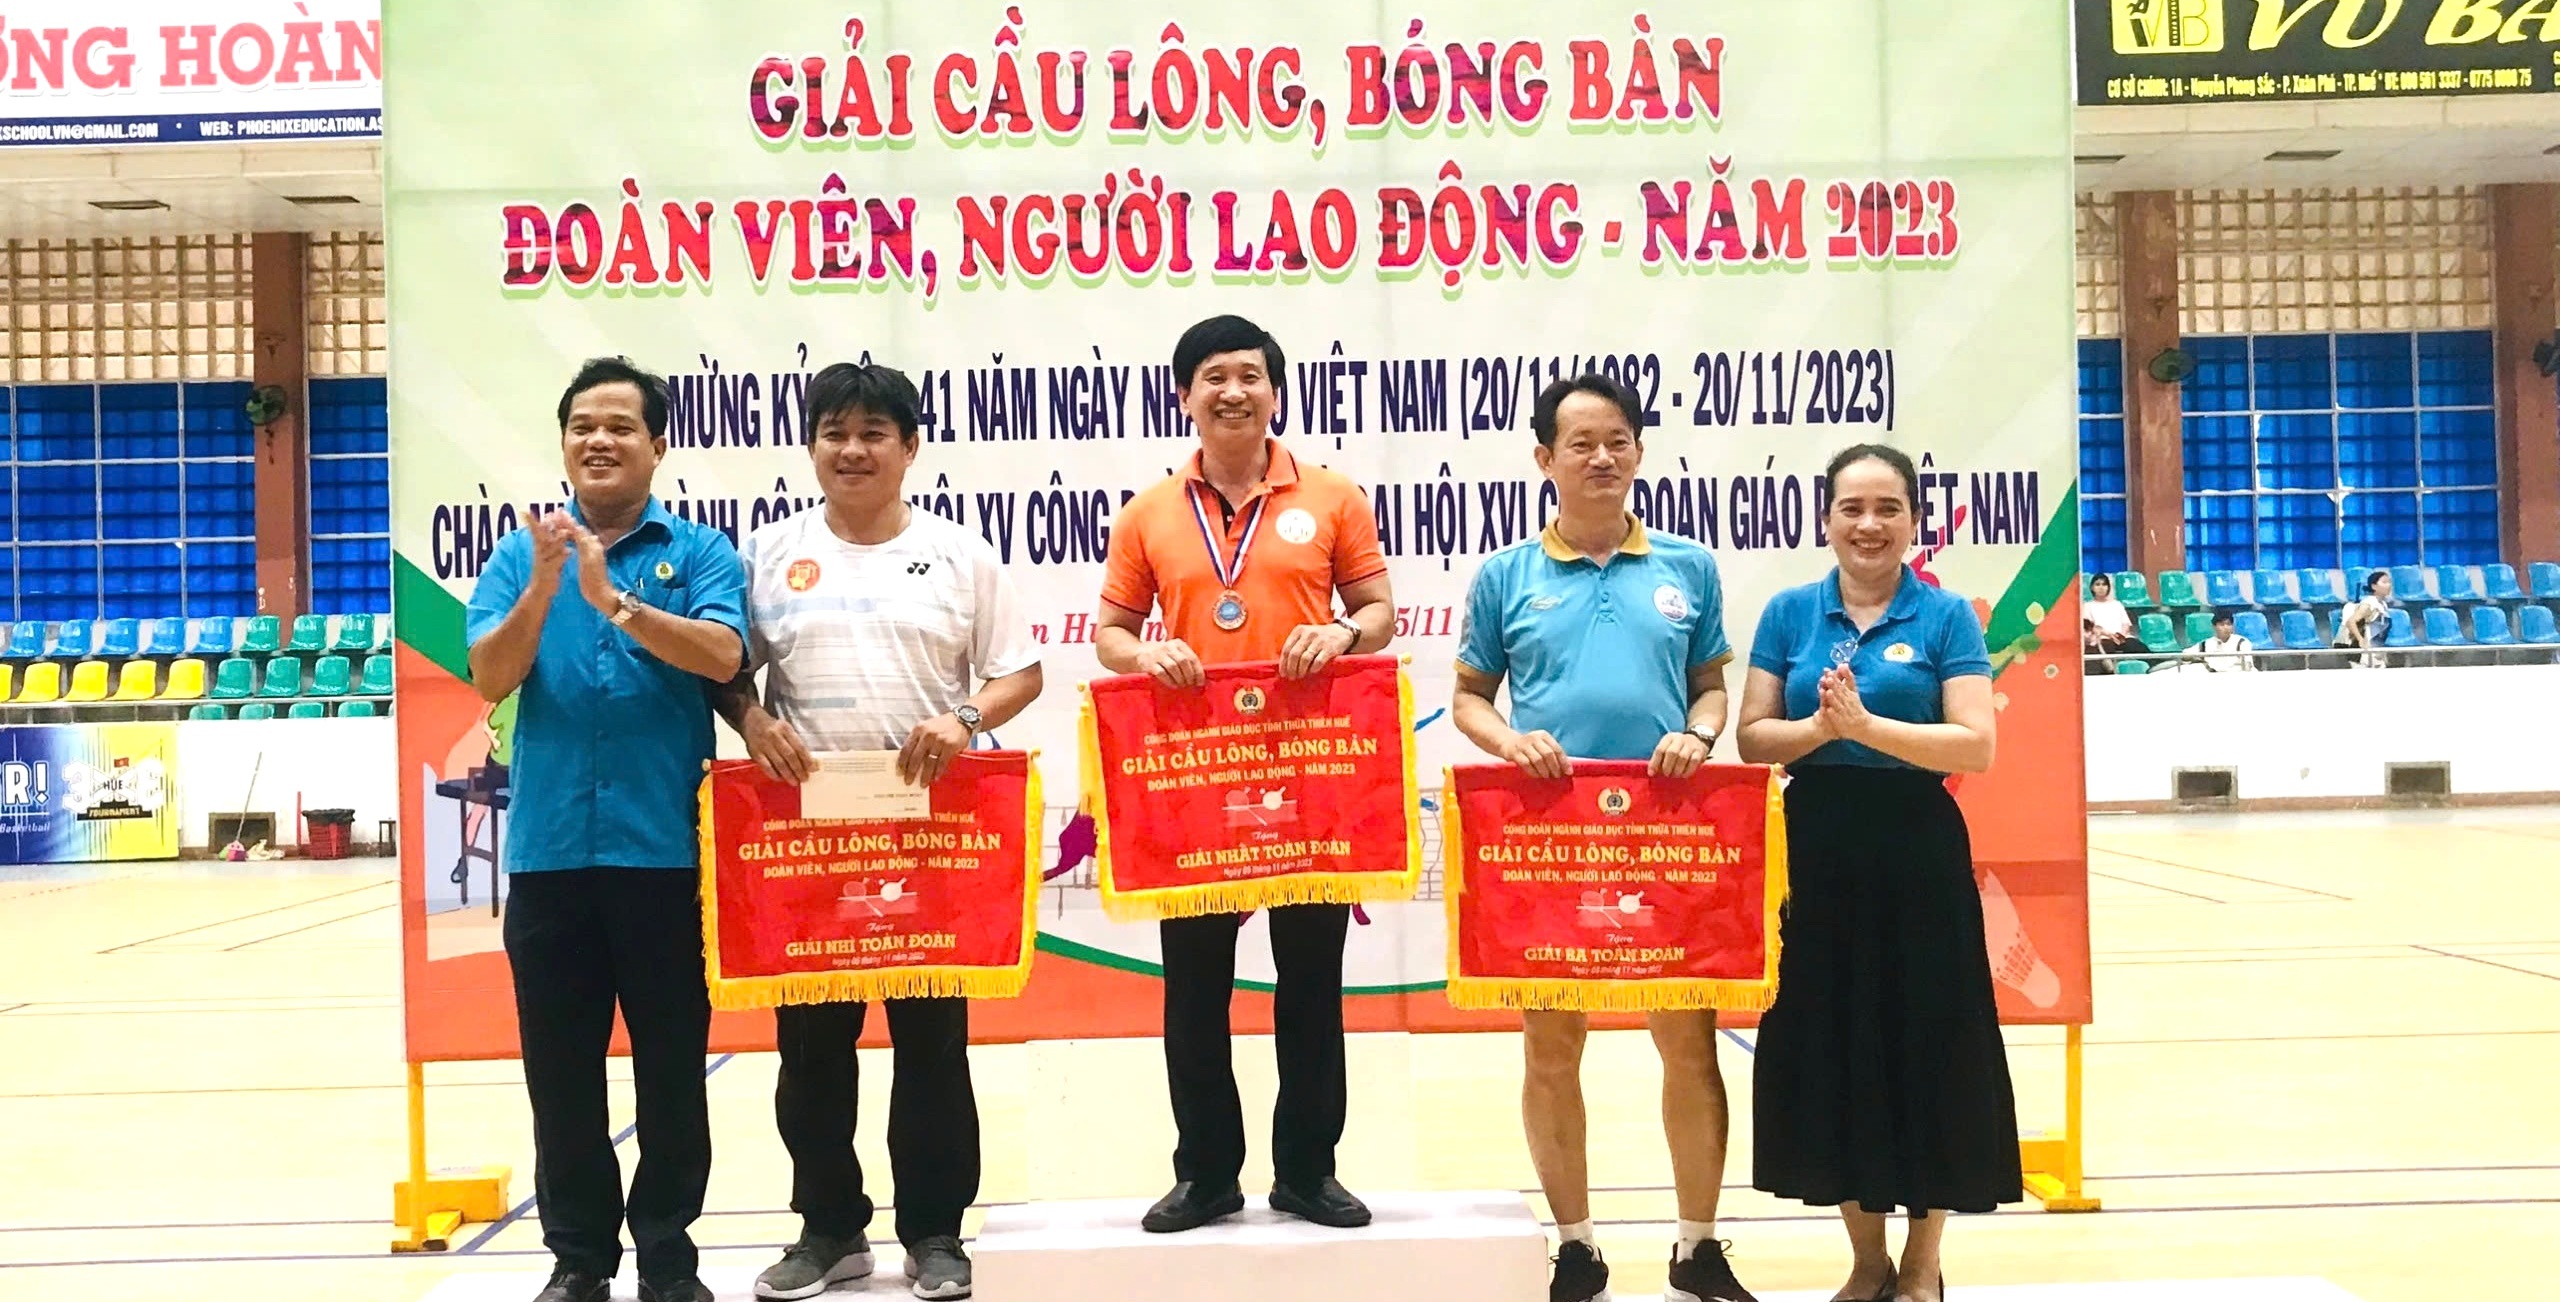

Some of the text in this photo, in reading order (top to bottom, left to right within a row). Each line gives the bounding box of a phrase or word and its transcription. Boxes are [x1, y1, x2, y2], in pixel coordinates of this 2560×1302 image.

[0, 15, 136, 90] NG
[749, 6, 1725, 146] GIẢI CẦU LÔNG, BÓNG BÀN
[2171, 77, 2183, 97] 1A
[2283, 75, 2291, 94] P.
[2343, 73, 2356, 92] TP.
[200, 121, 234, 136] WEB:
[502, 177, 715, 286] ĐOÀN
[733, 172, 940, 298] VIÊN,
[956, 167, 1194, 280] NGƯỜI
[1212, 187, 1358, 272] LAO
[1376, 159, 1584, 288] ĐỘNG
[1638, 155, 1808, 263] NĂM
[1825, 179, 1959, 259] 2023
[667, 353, 761, 449] MỪNG
[967, 352, 1039, 442] NĂM
[1050, 345, 1130, 441] NGÀY
[1142, 365, 1201, 438] NH
[1297, 340, 1368, 451] VIỆT
[1380, 358, 1448, 433] NAM
[1025, 470, 1111, 566] CÔNG
[1414, 461, 1467, 572] HỘI
[1729, 455, 1803, 551] GIÁO
[1971, 470, 2040, 545] NAM
[1122, 734, 1377, 775] GIẢI CẦU LÔNG, BÓNG BÀN
[1, 761, 49, 804] R!
[1244, 768, 1264, 781] LAO
[1329, 763, 1356, 775] 2023
[739, 828, 1001, 861] GIẢI CẦU LÔNG, BÓNG BÀN
[1176, 847, 1213, 869] GIẢI
[1263, 838, 1307, 859] TOÀN
[1310, 836, 1351, 856] ĐOÀN
[1478, 838, 1742, 866] GIẢI CẦU LÔNG, BÓNG BÀN
[864, 859, 885, 872] LAO
[954, 857, 980, 869] 2023
[1601, 870, 1623, 882] LAO
[1691, 871, 1718, 883] 2023
[785, 937, 822, 957] GIẢI
[859, 932, 905, 952] TOÀN
[908, 930, 957, 948] ĐOÀN
[1524, 943, 1686, 963] GIẢI BA TOÀN ĐOÀN
